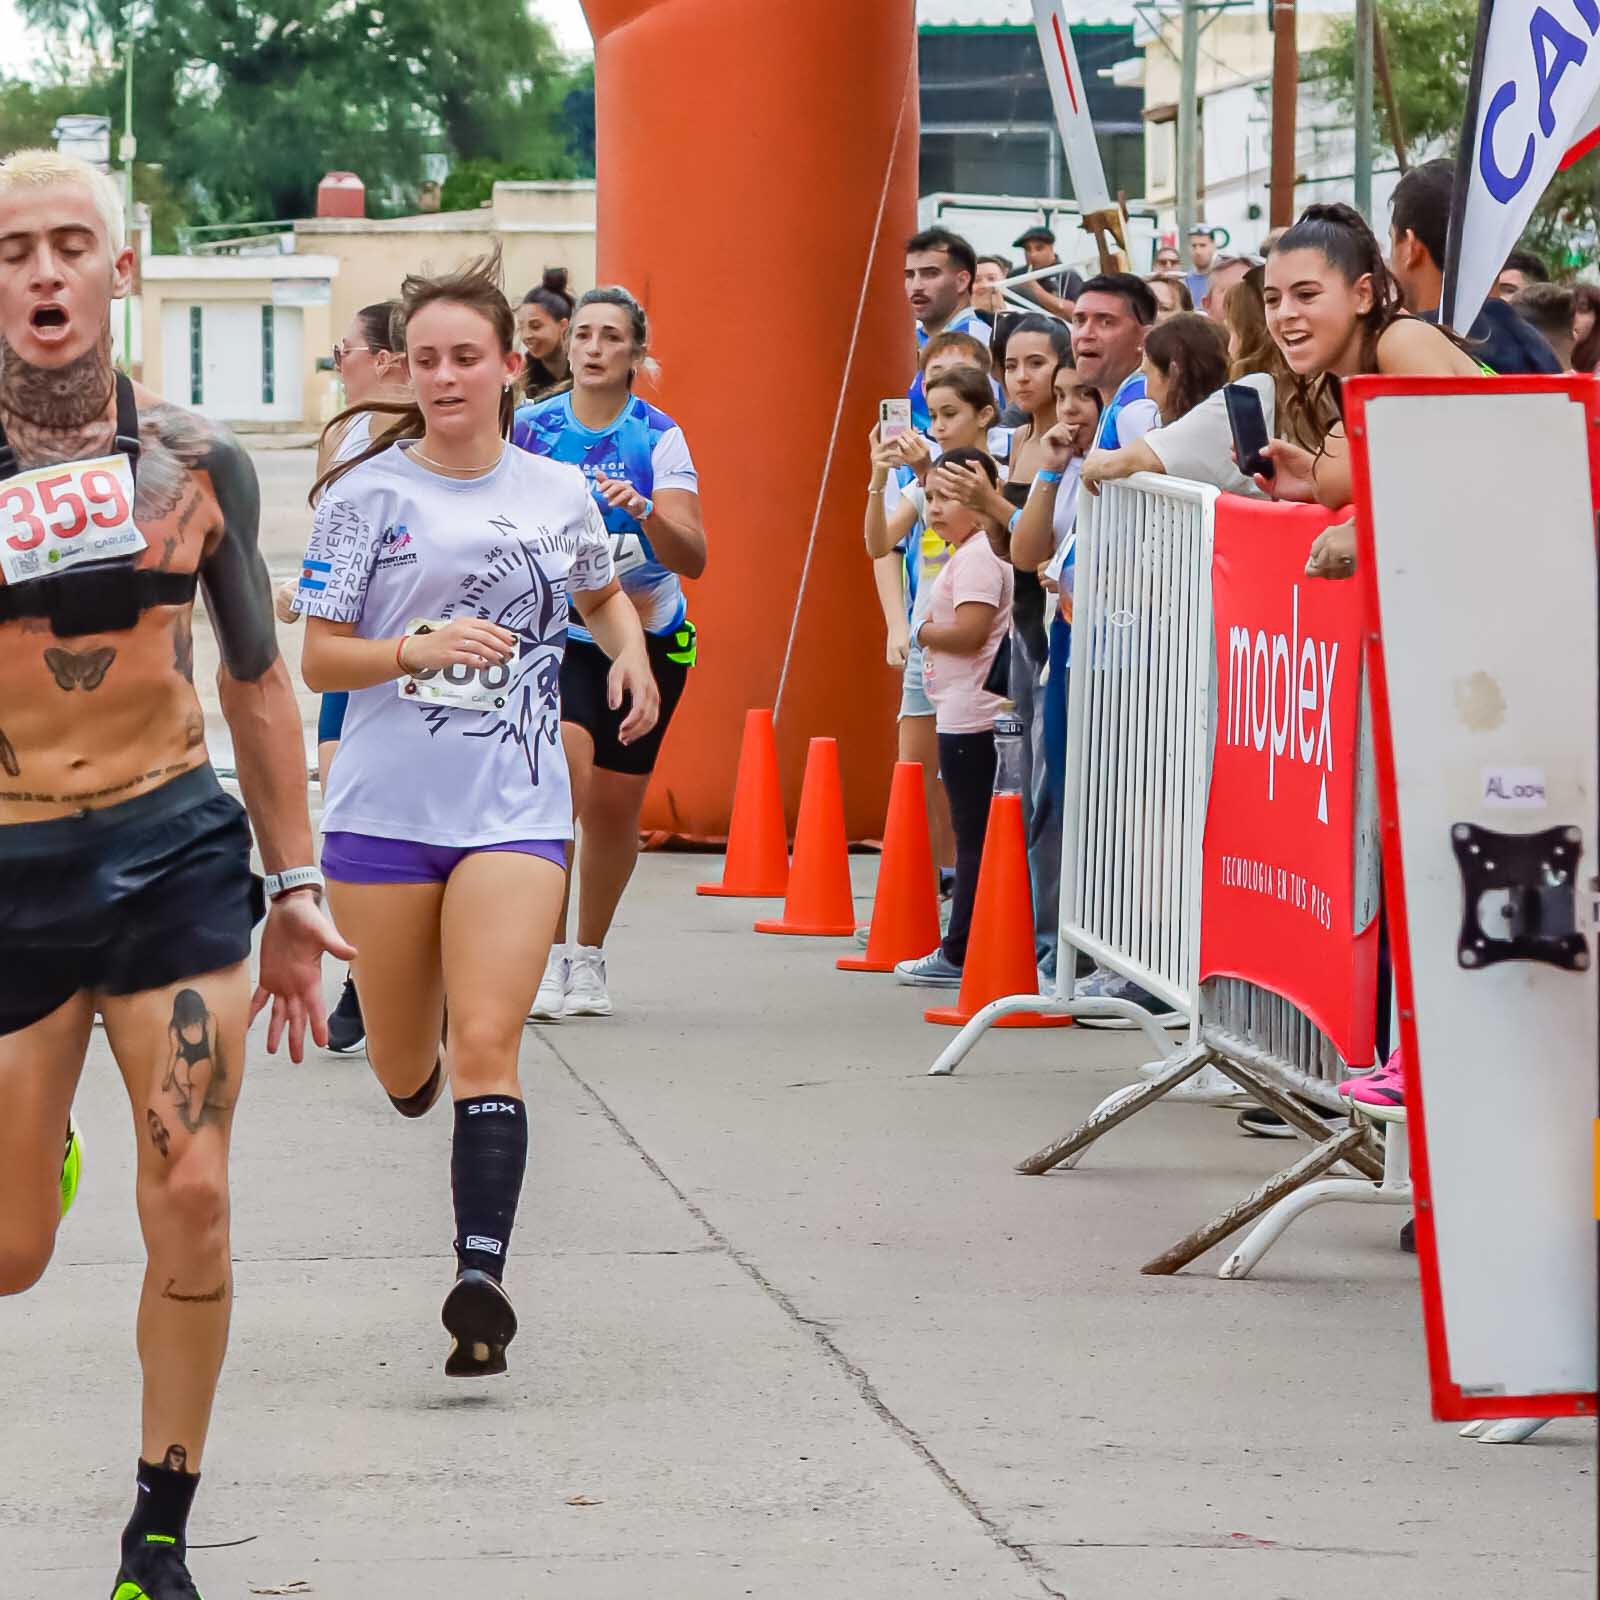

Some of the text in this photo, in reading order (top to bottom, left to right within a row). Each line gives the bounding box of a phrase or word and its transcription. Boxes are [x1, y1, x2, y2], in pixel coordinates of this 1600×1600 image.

[324, 550, 354, 600] TRAIL
[1227, 584, 1339, 801] moplex
[1222, 856, 1331, 930] TECNOLOGIA EN TUS PIES
